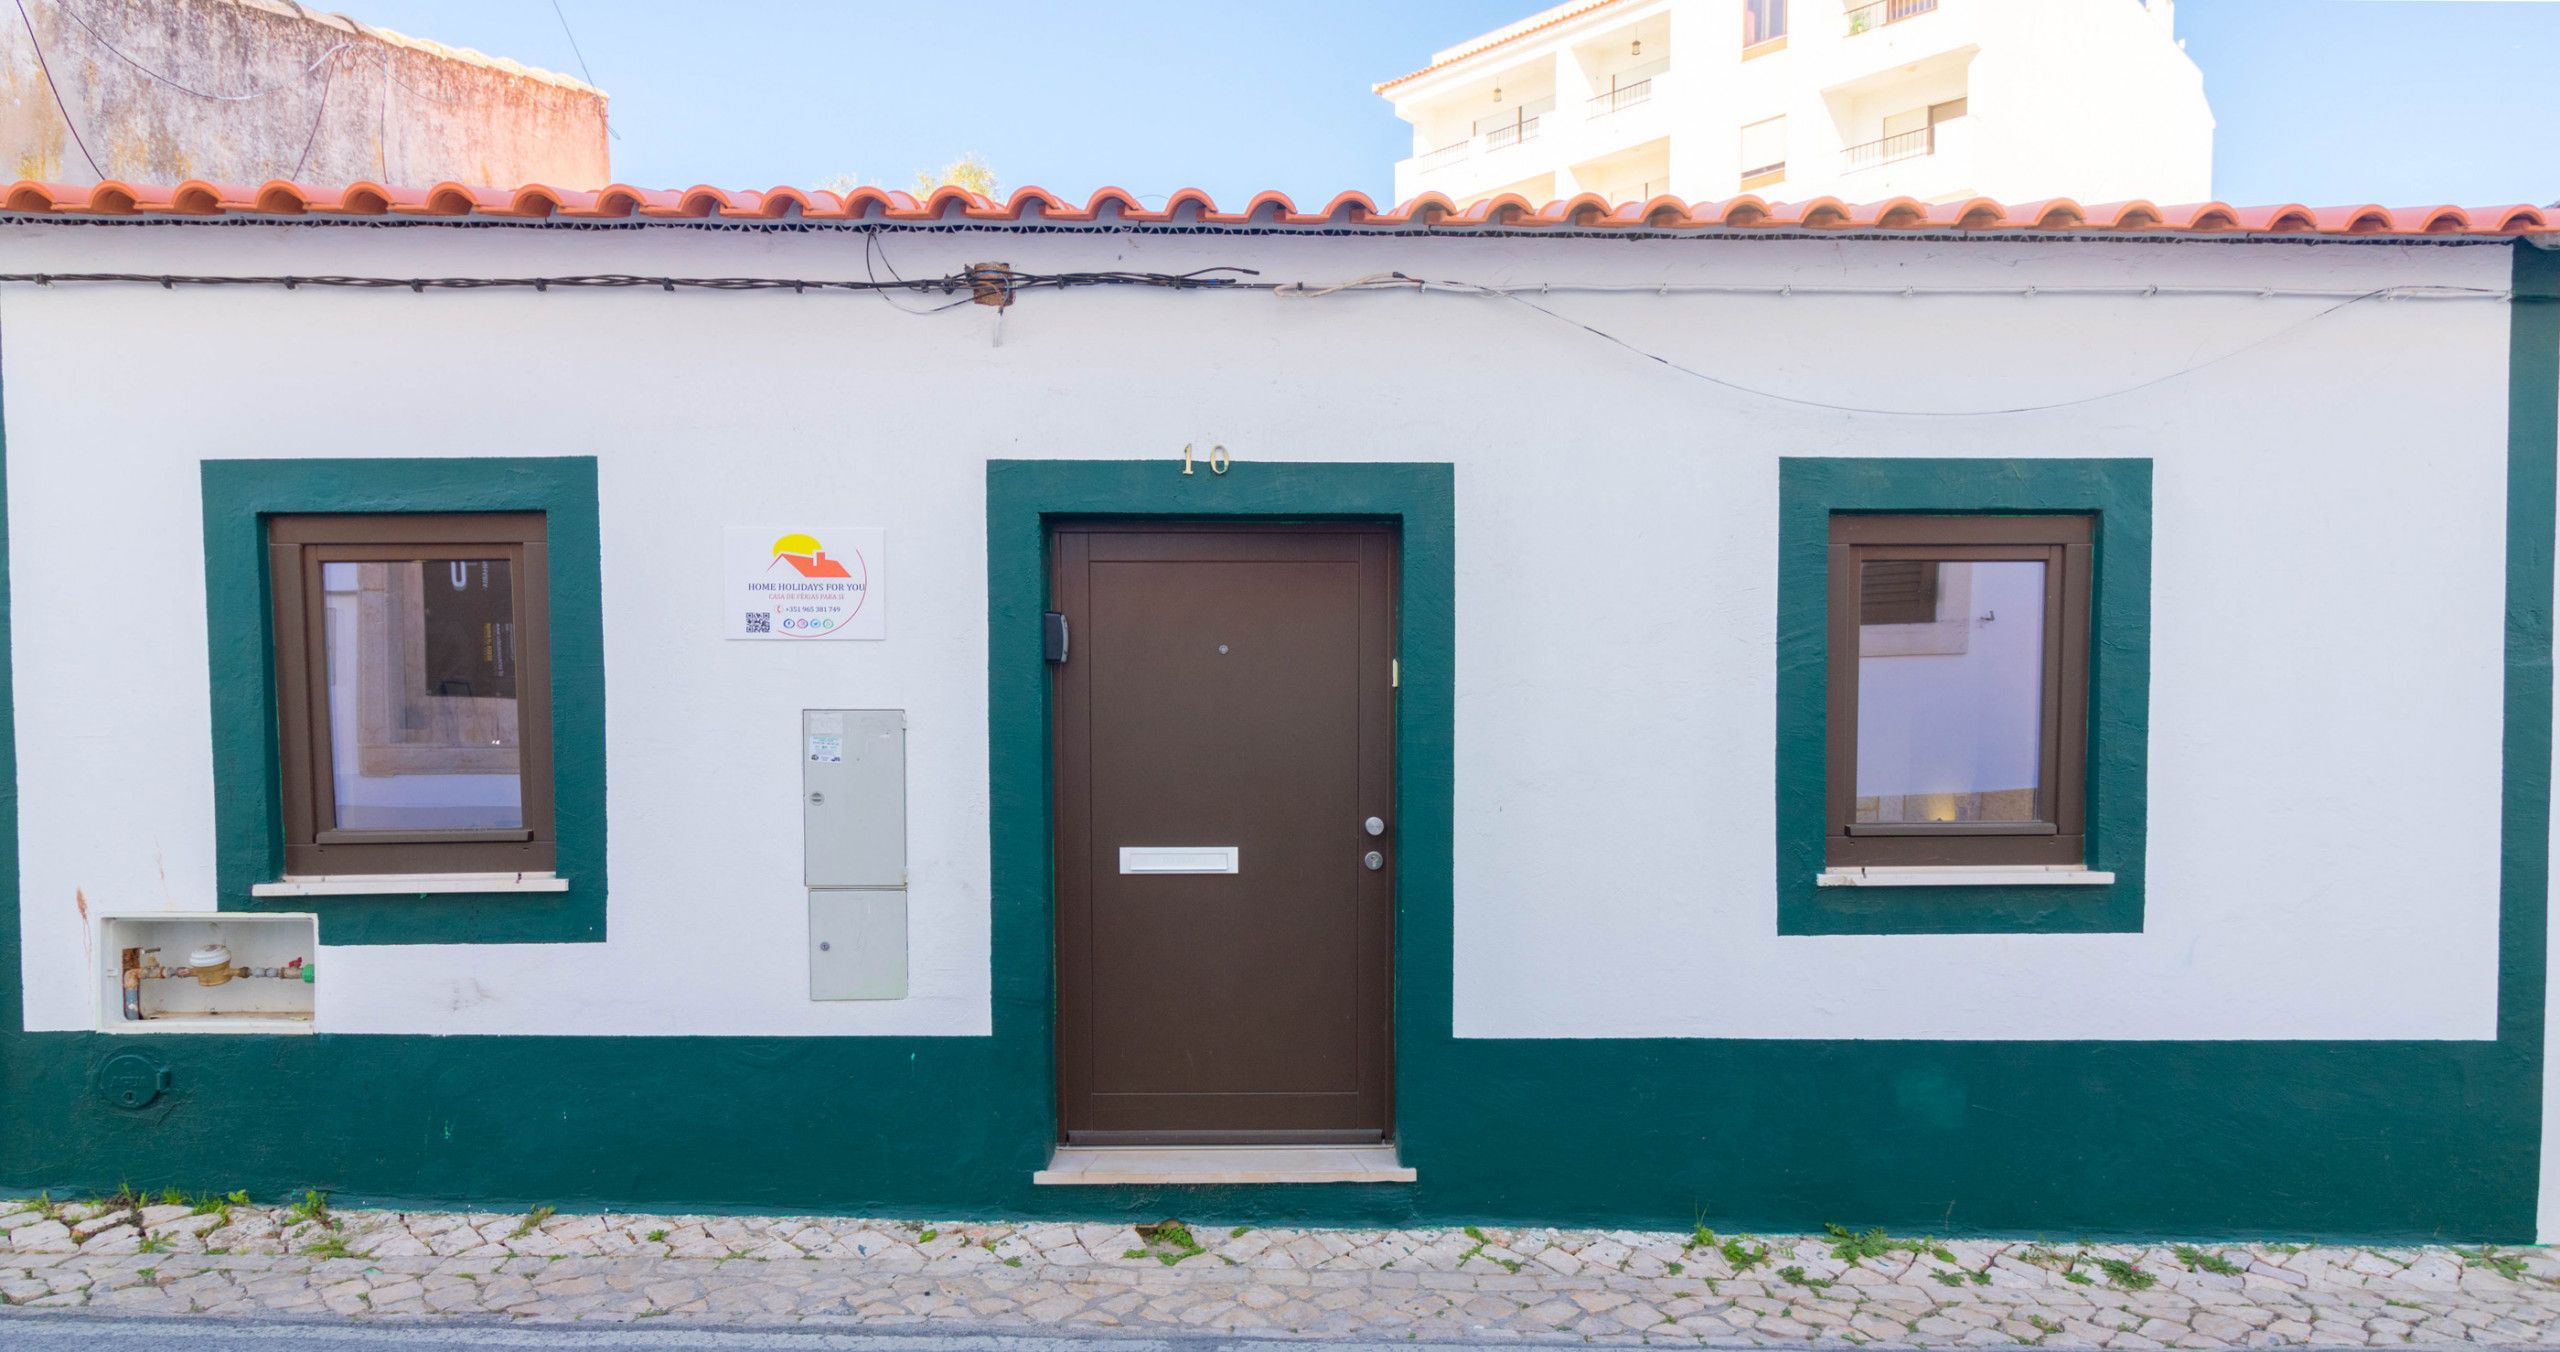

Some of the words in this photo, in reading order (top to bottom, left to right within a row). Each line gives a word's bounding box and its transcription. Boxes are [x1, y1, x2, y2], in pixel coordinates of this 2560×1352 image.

[1182, 443, 1230, 475] 10
[748, 583, 777, 591] HOME
[778, 583, 824, 591] HOLIDAYS
[826, 583, 844, 591] FOR
[846, 583, 865, 591] YOU
